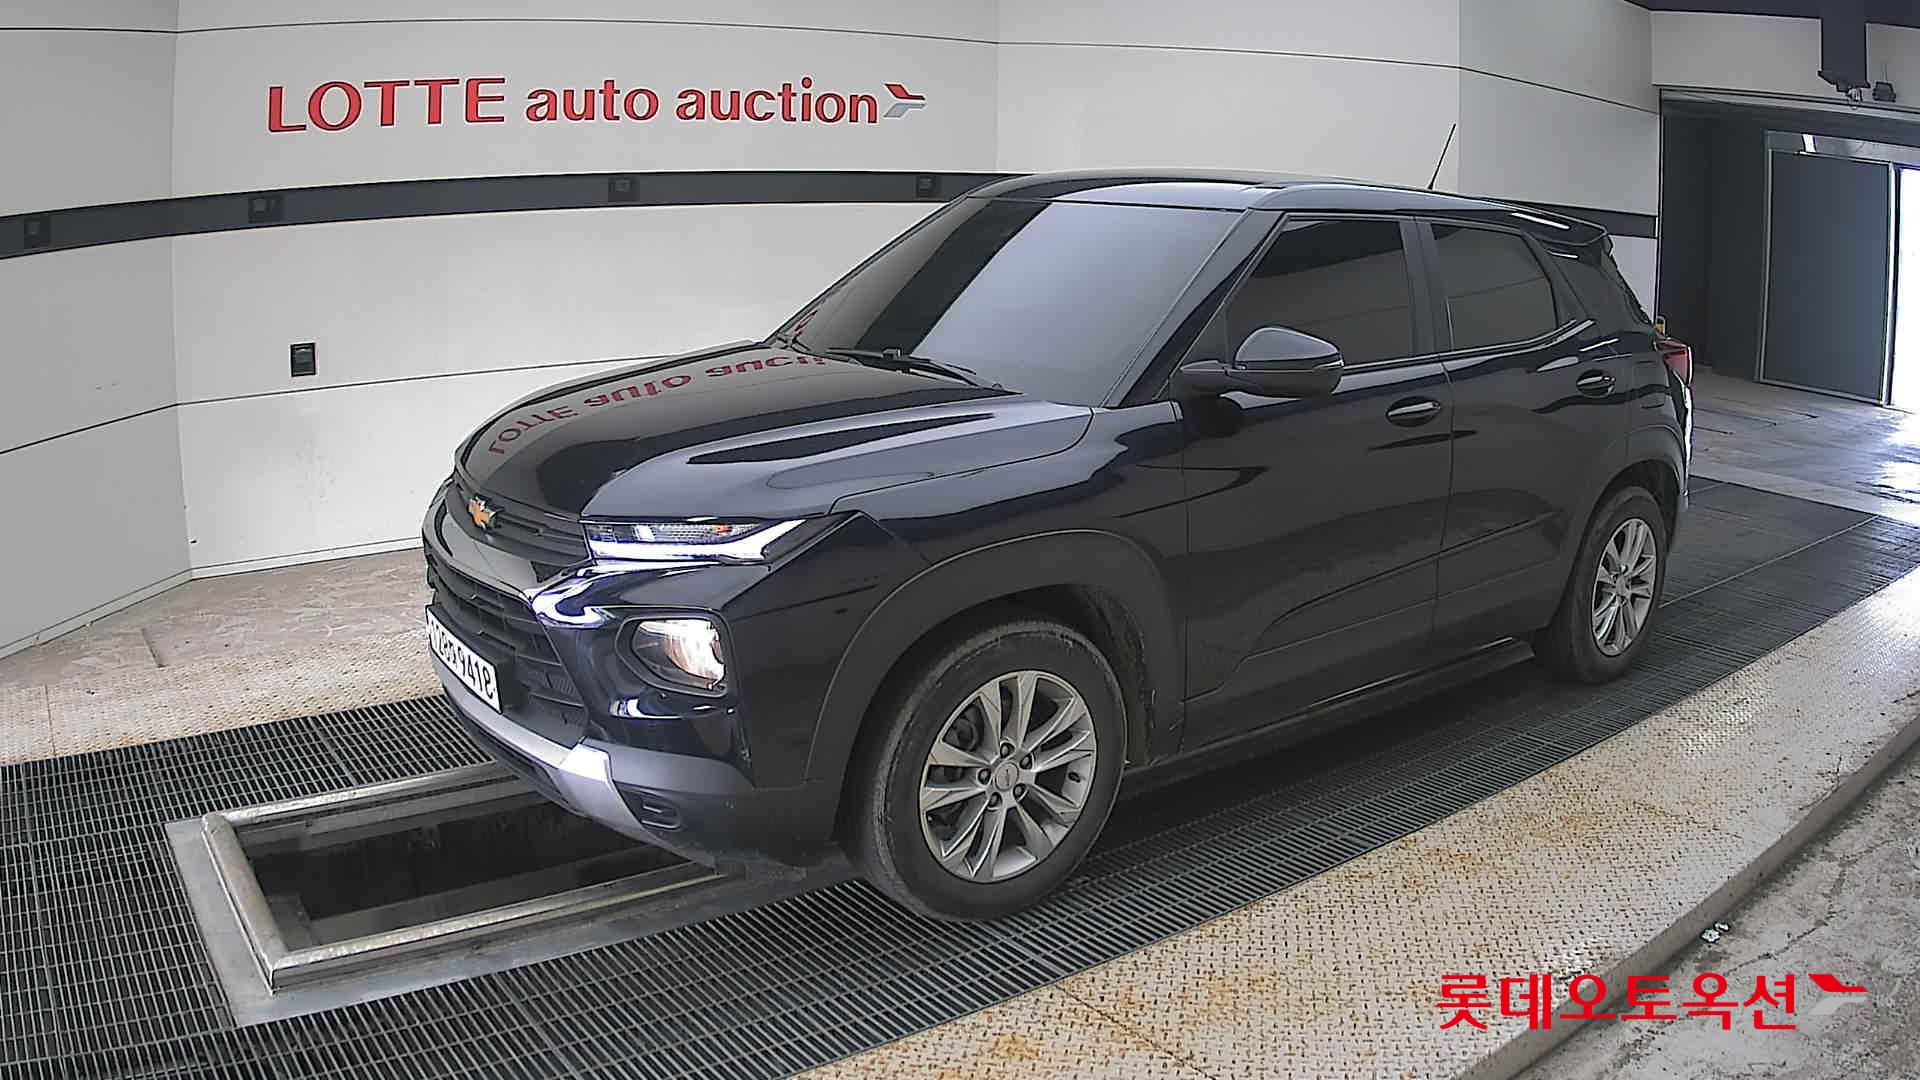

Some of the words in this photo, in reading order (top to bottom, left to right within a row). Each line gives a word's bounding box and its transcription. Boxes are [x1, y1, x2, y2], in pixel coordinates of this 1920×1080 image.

[269, 77, 505, 132] LOTTE
[526, 79, 659, 121] auto
[675, 77, 878, 123] auction
